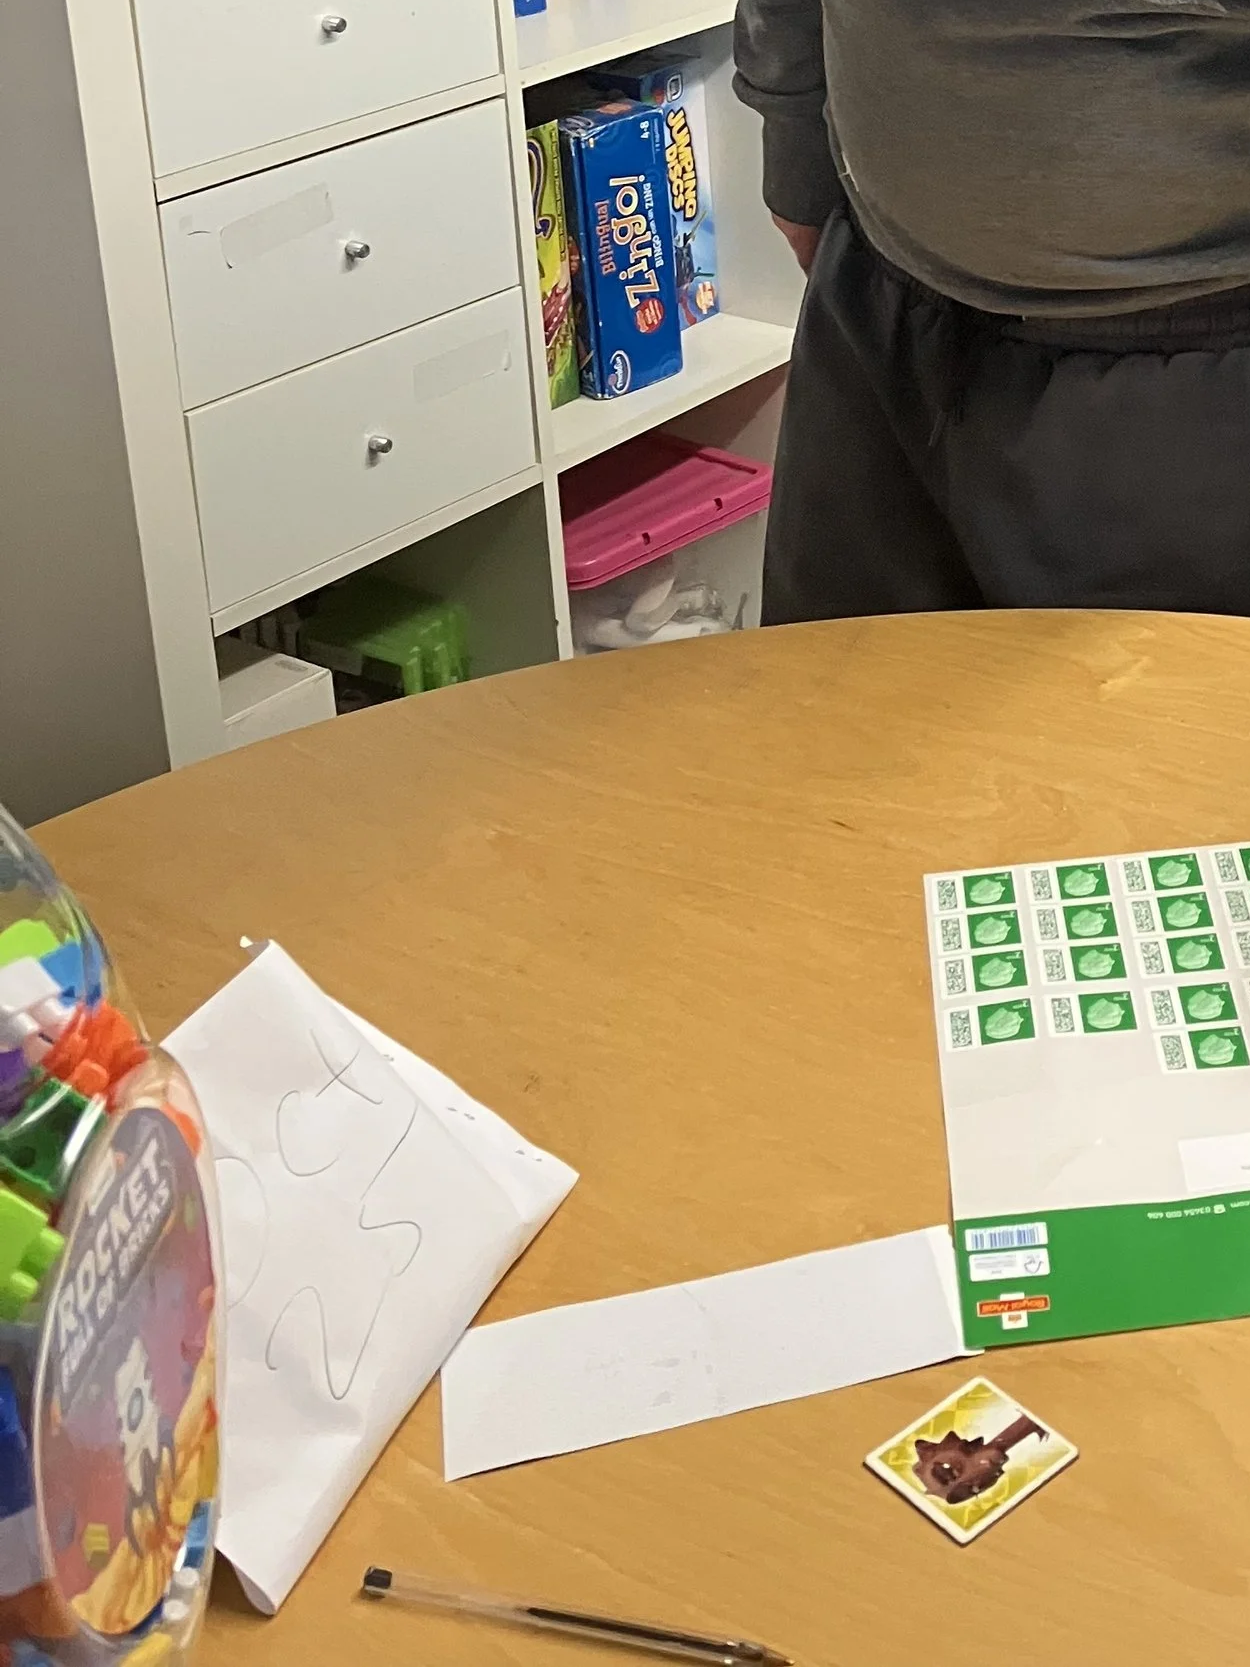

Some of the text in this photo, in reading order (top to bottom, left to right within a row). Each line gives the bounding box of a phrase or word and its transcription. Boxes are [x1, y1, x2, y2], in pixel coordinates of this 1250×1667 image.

[643, 182, 654, 209] ZING
[665, 150, 685, 212] DISCS
[666, 109, 697, 221] JUMPING
[597, 199, 616, 275] Bilingual
[609, 175, 660, 309] Zingo!
[652, 235, 664, 268] BINGO
[57, 1136, 159, 1352] ROCKET
[981, 1299, 1046, 1314] Royal Mail
